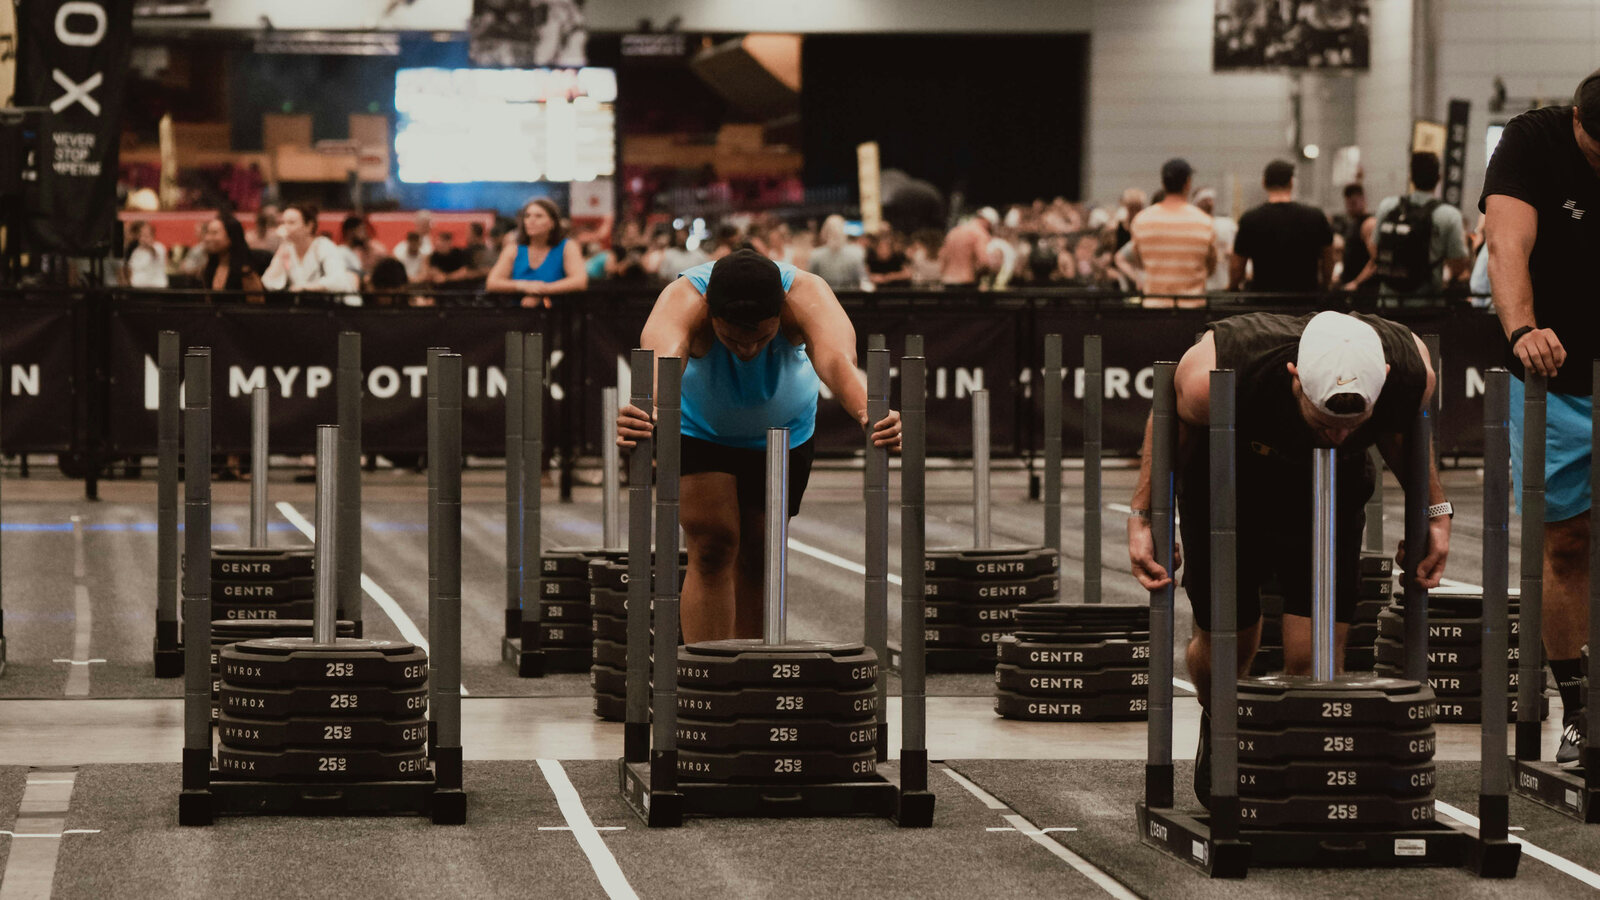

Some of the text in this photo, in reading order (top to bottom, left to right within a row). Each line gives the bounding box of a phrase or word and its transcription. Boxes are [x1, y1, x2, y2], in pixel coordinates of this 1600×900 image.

[54, 146, 89, 162] STOP
[221, 563, 271, 573] CENTR
[976, 562, 1025, 573] CENTR
[224, 586, 274, 596] CENTR
[978, 585, 1027, 597] CENTR
[227, 609, 277, 620] CENTR
[1030, 651, 1084, 662] CENTR
[227, 664, 262, 677] HYROX
[676, 666, 709, 678] HYROX
[1030, 677, 1083, 689] CENTR
[228, 696, 265, 708] HYROX
[677, 698, 712, 710] HYROX
[1028, 703, 1082, 714] CENTR
[225, 727, 259, 739] HYROX
[223, 758, 255, 770] HYROX
[676, 761, 710, 772] HYROX
